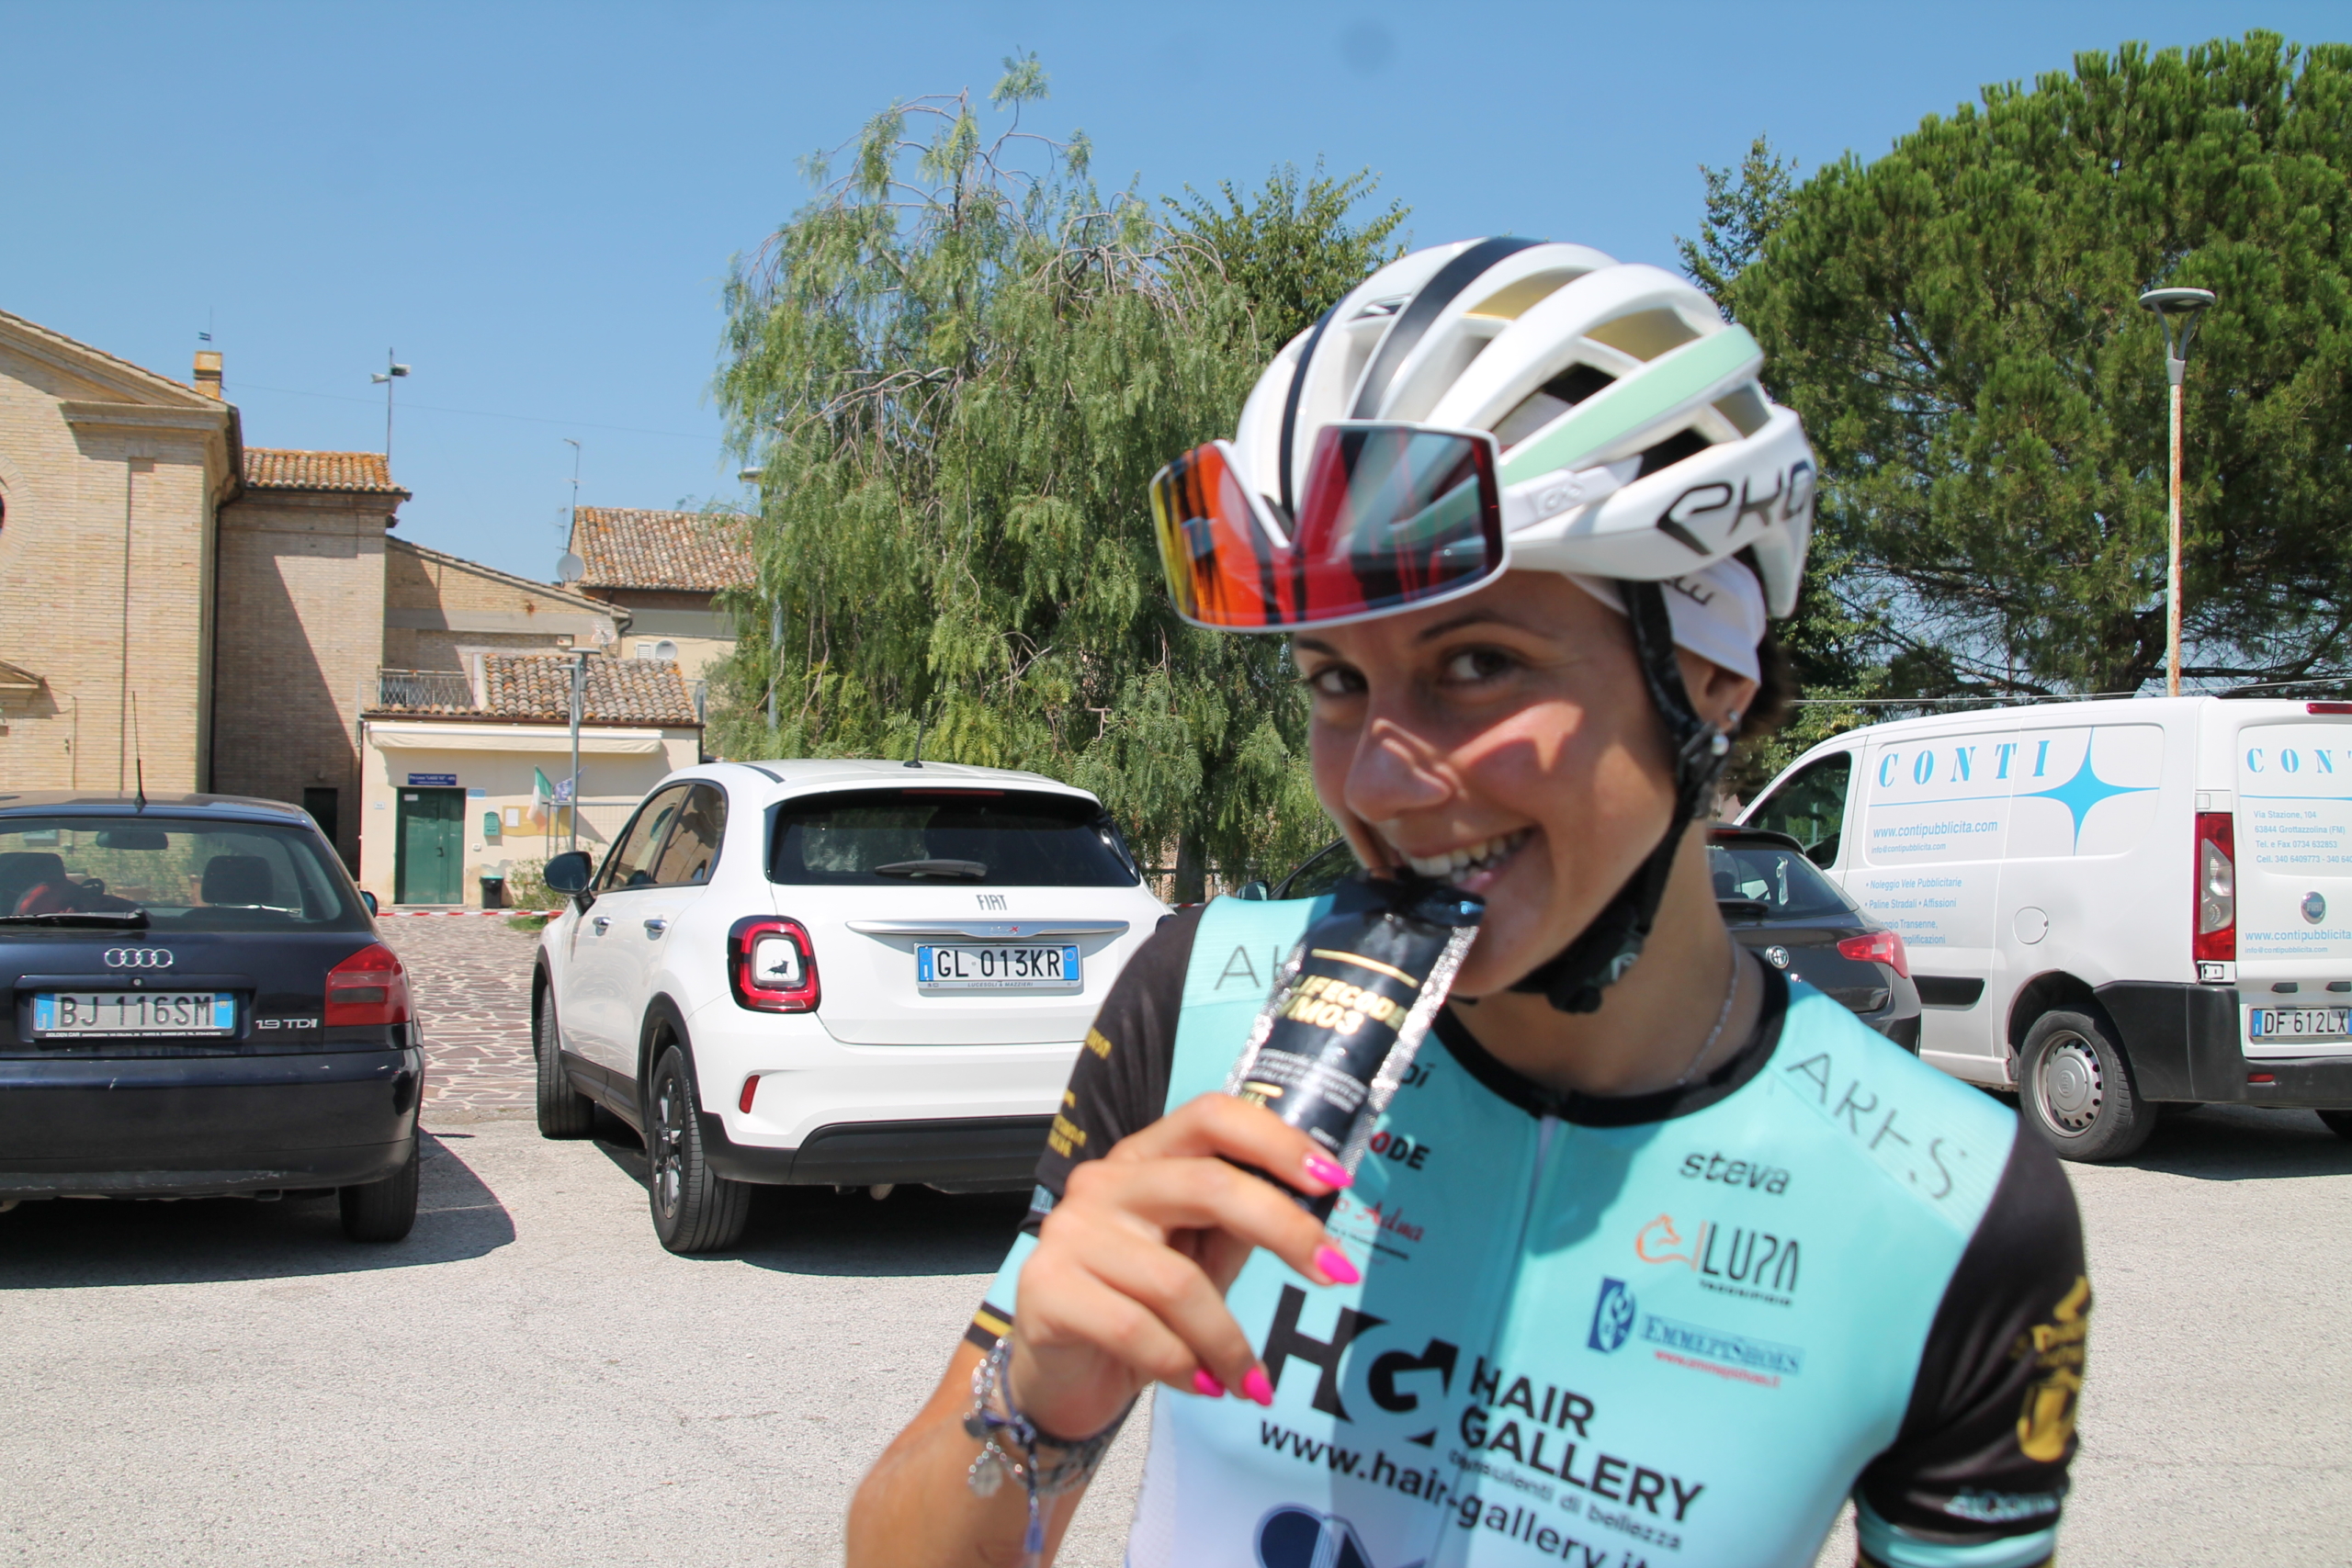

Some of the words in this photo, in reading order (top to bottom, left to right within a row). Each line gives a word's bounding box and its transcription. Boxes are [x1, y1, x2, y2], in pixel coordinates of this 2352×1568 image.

[1878, 739, 2051, 788] CONTI
[2246, 747, 2352, 773] CON
[2253, 810, 2266, 818] Via
[2267, 810, 2302, 819] Stazione,
[2304, 810, 2317, 818] 104
[1872, 820, 1998, 839] www.contipubblicita.com
[2254, 825, 2277, 833] 63844
[2278, 825, 2327, 834] Grottazzolina
[2329, 825, 2346, 835] (FM)
[1871, 841, 1947, 854] info@contipubblicita.com
[2256, 855, 2273, 863] Cell.
[2275, 855, 2289, 863] 340
[2290, 855, 2320, 863] 6409773
[2326, 855, 2340, 863] 340
[1870, 879, 1900, 891] Noleggio
[1901, 878, 1916, 888] Vele
[1917, 876, 1962, 888] Pubblicitarie
[976, 895, 1008, 910] FIAT
[1869, 899, 1890, 909] Paline
[1891, 898, 1917, 908] Stradali
[1923, 897, 1957, 908] Affissioni
[2306, 902, 2324, 912] FIAT
[1900, 919, 1939, 930] Transenne,
[1902, 933, 1946, 946] mplificazioni
[2245, 929, 2352, 942] www.contipubblicita
[2245, 946, 2328, 955] info@contipubblicita.com
[937, 950, 969, 977] GL
[980, 950, 1060, 977] 013KR
[60, 996, 98, 1027] BJ
[115, 995, 211, 1027] 116SM
[283, 1019, 318, 1029] TDI
[2265, 1012, 2286, 1033] DF
[2293, 1011, 2346, 1033] 612LX
[1369, 1131, 1431, 1171] ODE
[1679, 1152, 1791, 1195] steva
[1468, 1355, 1595, 1438] HAIR
[1460, 1404, 1704, 1522] GALLERY
[1261, 1419, 1651, 1568] www.hair-galleryi
[1560, 1493, 1581, 1514] di
